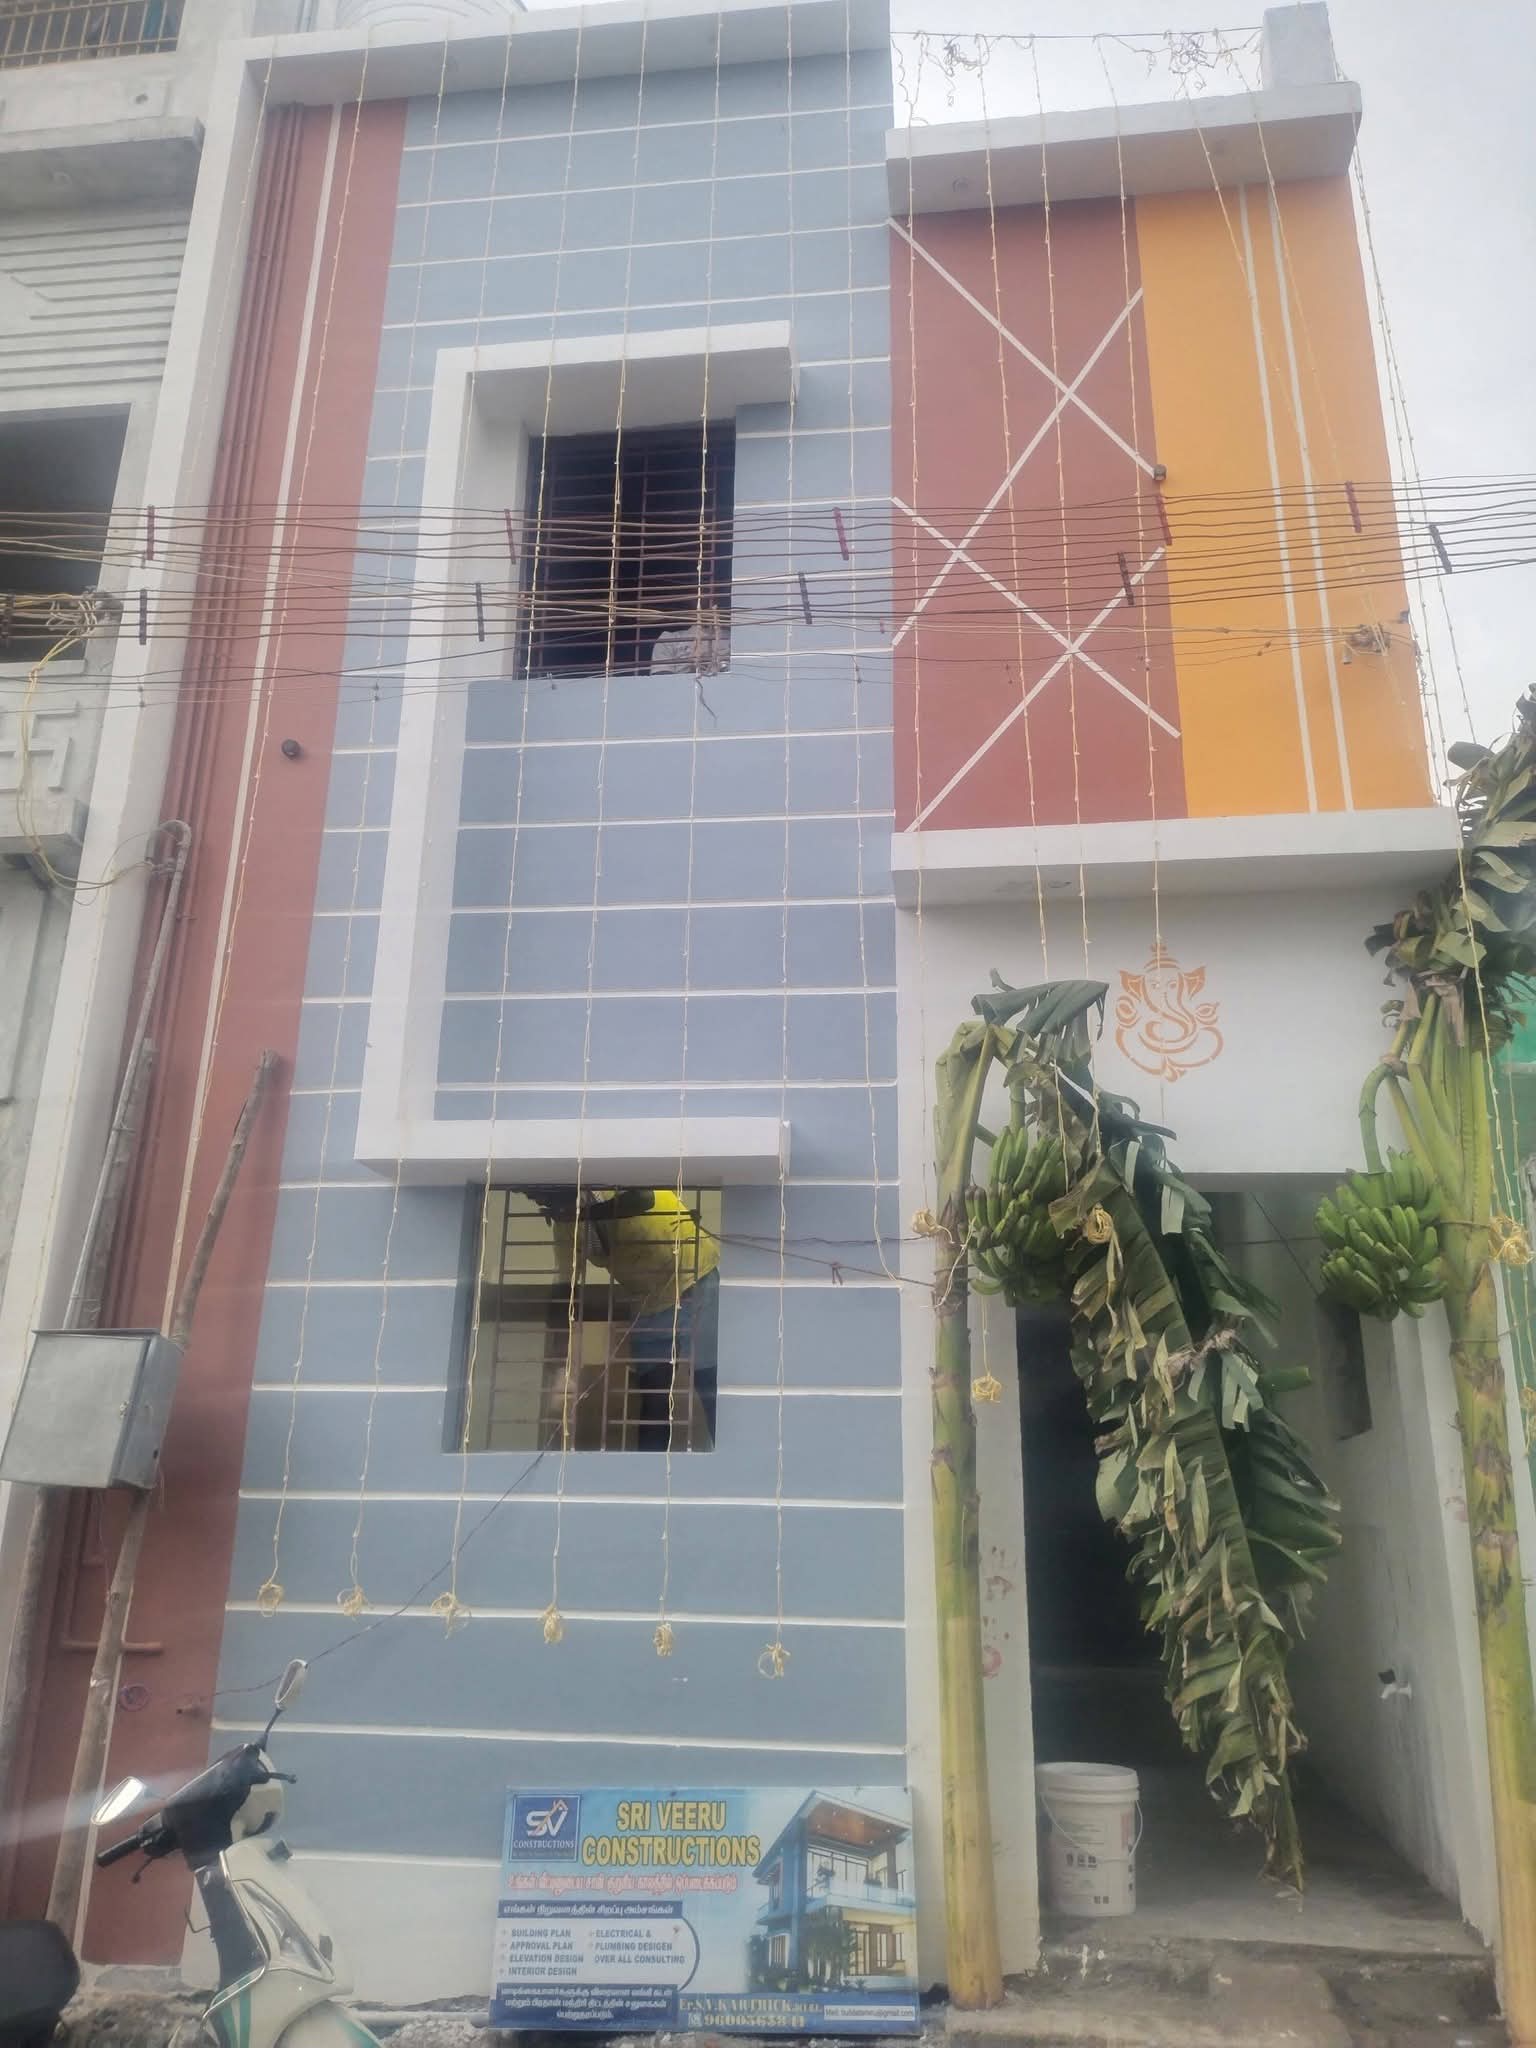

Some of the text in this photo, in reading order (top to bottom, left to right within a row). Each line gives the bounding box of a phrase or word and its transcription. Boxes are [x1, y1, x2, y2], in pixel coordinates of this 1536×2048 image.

[617, 1800, 726, 1831] SRI VEERU
[513, 1840, 575, 1849] CONSTRUCTIONS
[582, 1835, 761, 1867] CONSTRUCTIONS
[511, 1928, 572, 1938] BUILDING PLAN
[596, 1929, 643, 1938] ELECTRICAL
[510, 1941, 573, 1951] APPROVAL PLAN
[595, 1942, 636, 1951] PLUMBING
[510, 1953, 584, 1963] ELEVATION DESIGN
[594, 1954, 685, 1964] OVER ALL CONSULTING
[508, 1967, 577, 1977] INTERIOR DESIGN
